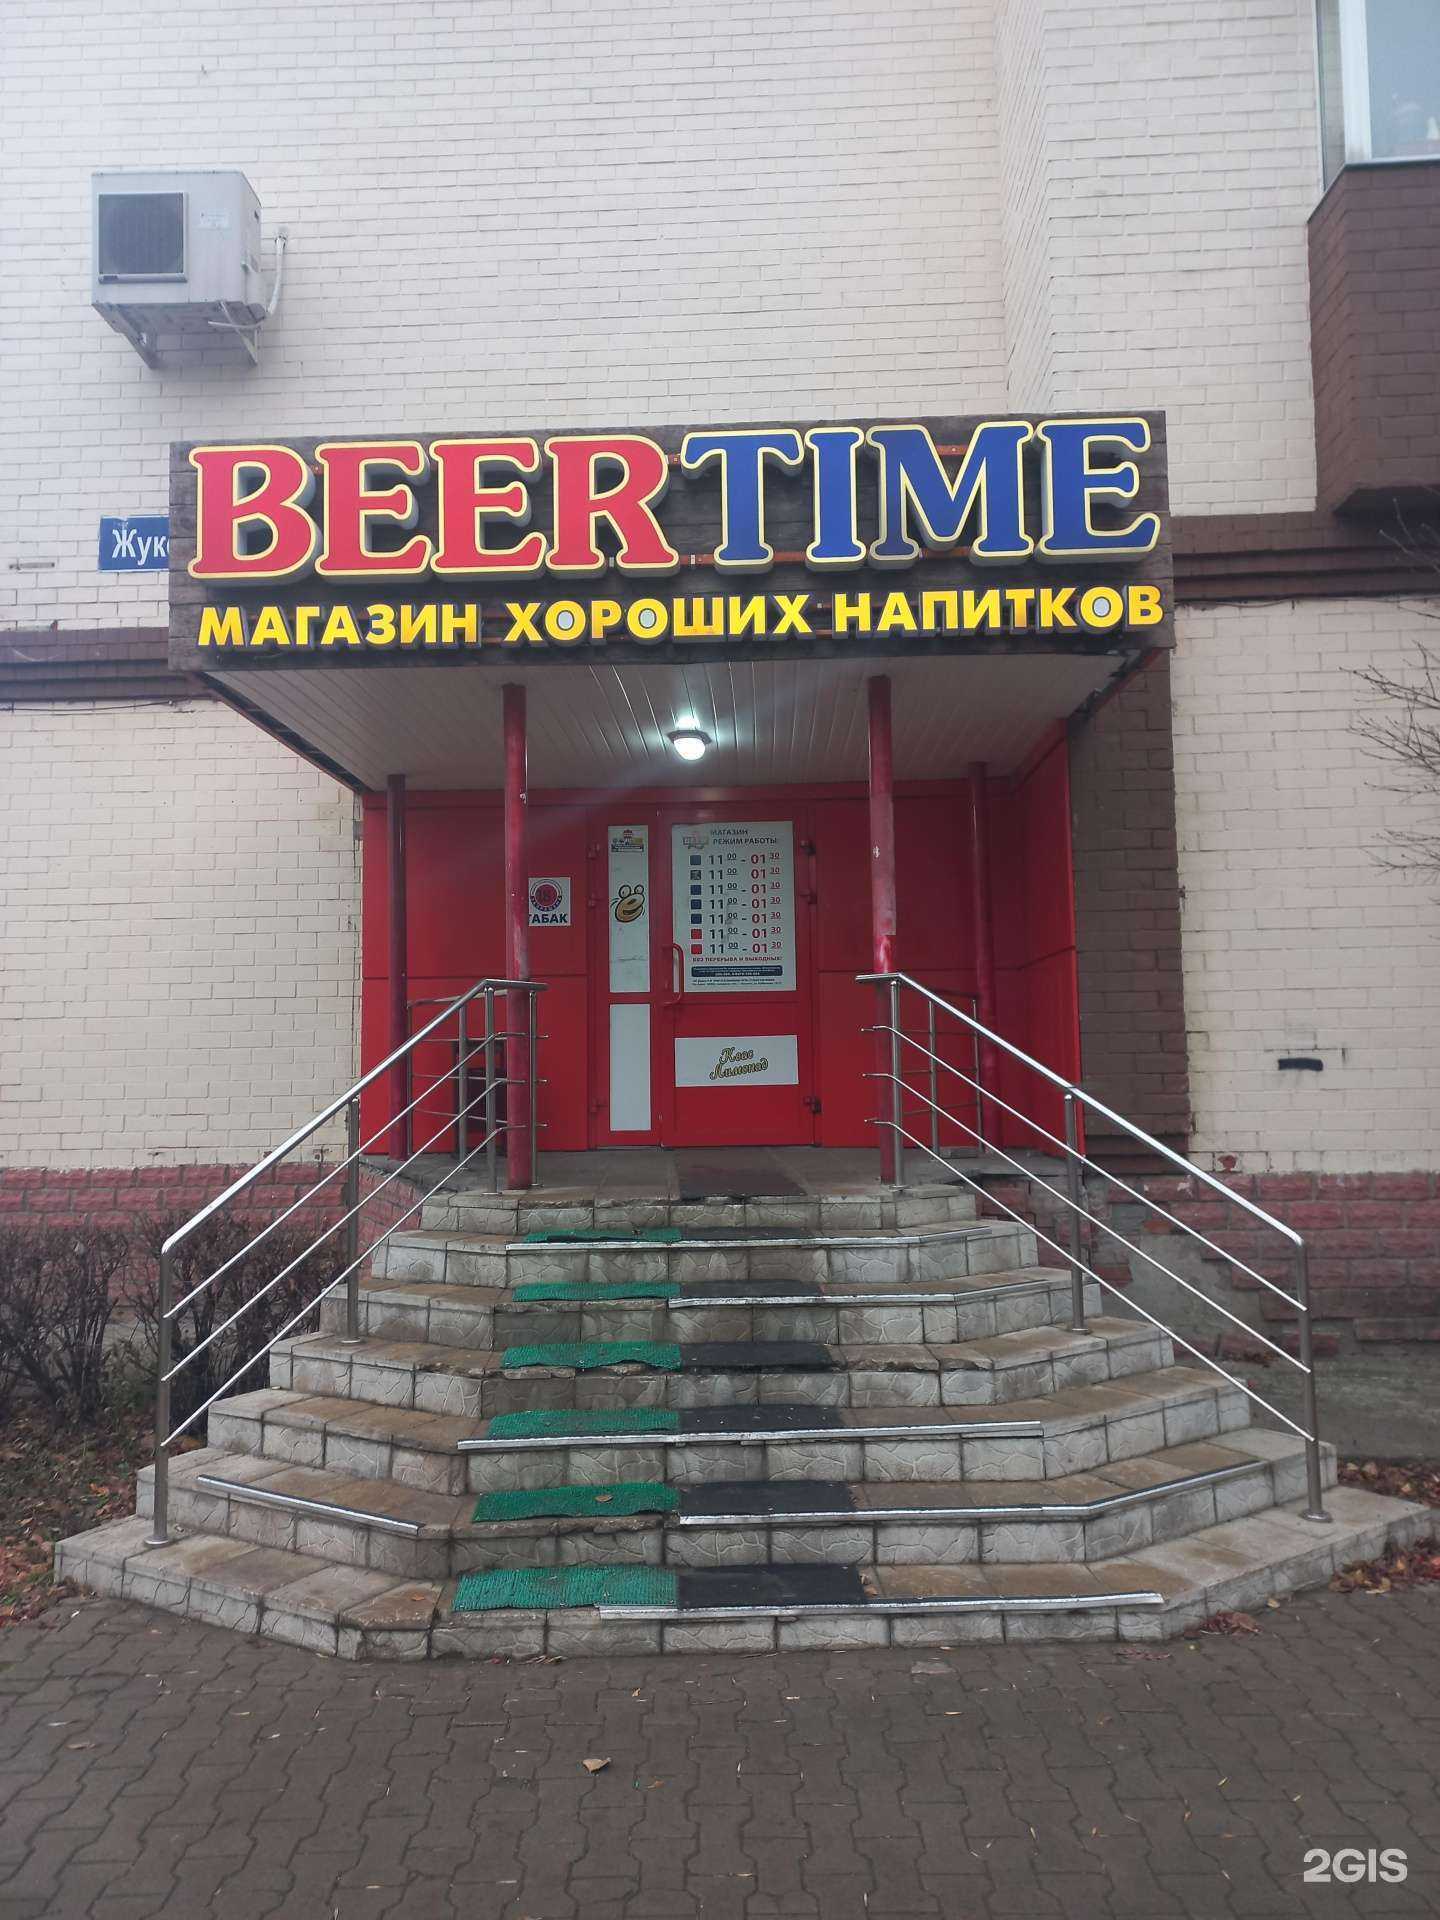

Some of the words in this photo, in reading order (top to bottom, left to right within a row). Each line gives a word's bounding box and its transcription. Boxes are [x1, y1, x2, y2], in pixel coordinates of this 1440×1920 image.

[112, 528, 169, 566] Жук
[198, 604, 479, 646] МАГАЗИН
[504, 594, 813, 642] ХОРОШИХ
[835, 585, 1164, 632] НАПИТКОВ
[713, 837, 743, 845] РЕЖИМ
[719, 1047, 754, 1065] Квас
[709, 1058, 769, 1081] Лимонад
